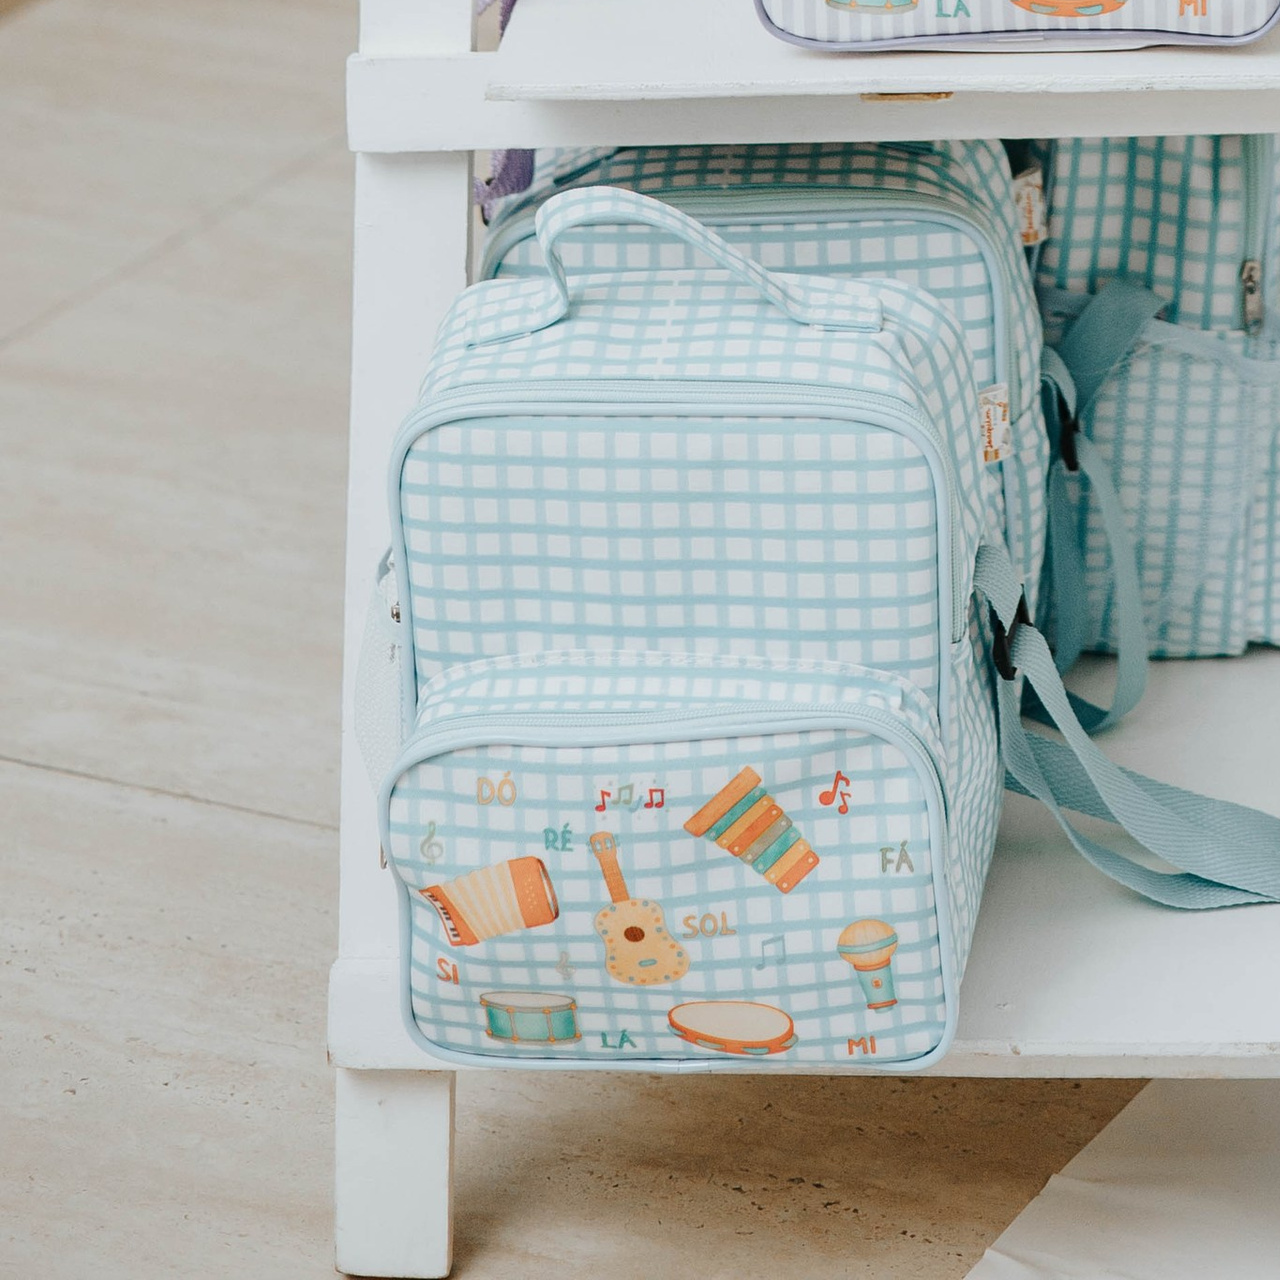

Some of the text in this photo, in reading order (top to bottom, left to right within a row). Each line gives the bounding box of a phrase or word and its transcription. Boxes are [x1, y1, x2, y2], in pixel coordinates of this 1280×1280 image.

[477, 771, 517, 807] DÓ
[543, 823, 575, 852] RÉ
[880, 840, 914, 874] FÁ
[682, 911, 736, 939] SOL
[436, 958, 460, 986] SI
[600, 1028, 637, 1050] LÁ
[847, 1035, 877, 1056] MI
